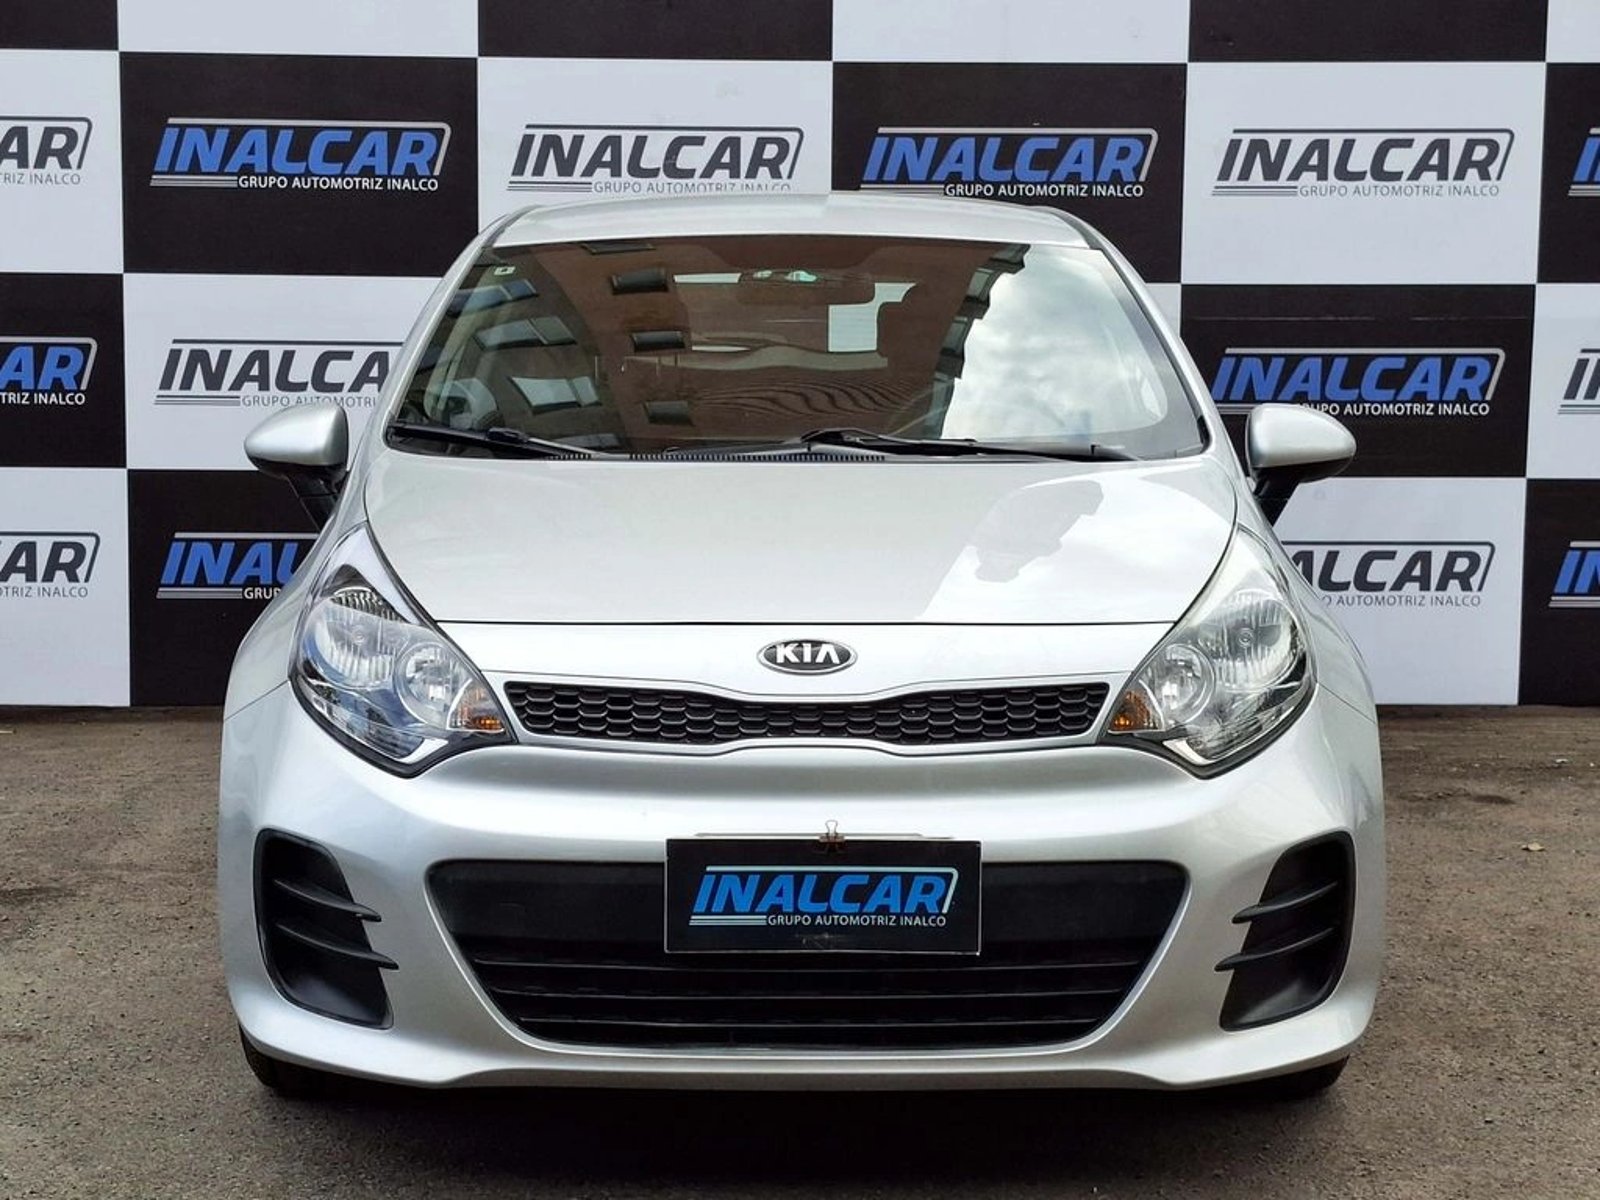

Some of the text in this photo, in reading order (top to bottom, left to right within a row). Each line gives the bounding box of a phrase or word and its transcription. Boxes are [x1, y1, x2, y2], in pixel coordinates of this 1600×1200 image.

[153, 127, 438, 176] INALCAR
[511, 134, 791, 180] INALCAR
[862, 137, 1145, 182] INALCAR
[1216, 138, 1501, 182] INALCAR
[29, 173, 81, 185] INALCO
[238, 175, 439, 191] GRUPO AUTOMOTRIZ INALCO
[594, 181, 642, 193] GRUPO
[646, 182, 736, 193] AUTOMOTRIZ
[945, 184, 1144, 197] GRUPO AUTOMOTRIZ INALCO
[1300, 185, 1500, 197] GRUPO AUTOMOTRIZ INALCO
[158, 348, 390, 393] INALCA
[1210, 356, 1492, 401] INALCAR
[34, 392, 86, 405] INALCO
[242, 395, 377, 407] GRUPO AUTOMOTRI
[1343, 403, 1434, 415] AUTOMOTRIZ
[1438, 403, 1490, 415] INALCO
[161, 541, 299, 584] INAL
[1292, 550, 1482, 592] ALCAR
[0, 587, 88, 598] TRIZ INALCO
[244, 587, 282, 599] GRUP
[1336, 595, 1426, 607] AUTOMOTRIZ
[1430, 595, 1481, 607] INALCO
[776, 643, 840, 664] KIA
[693, 874, 947, 913] INALCAR
[768, 915, 947, 927] GRUPO AUTOMOTRIZ INALCO
